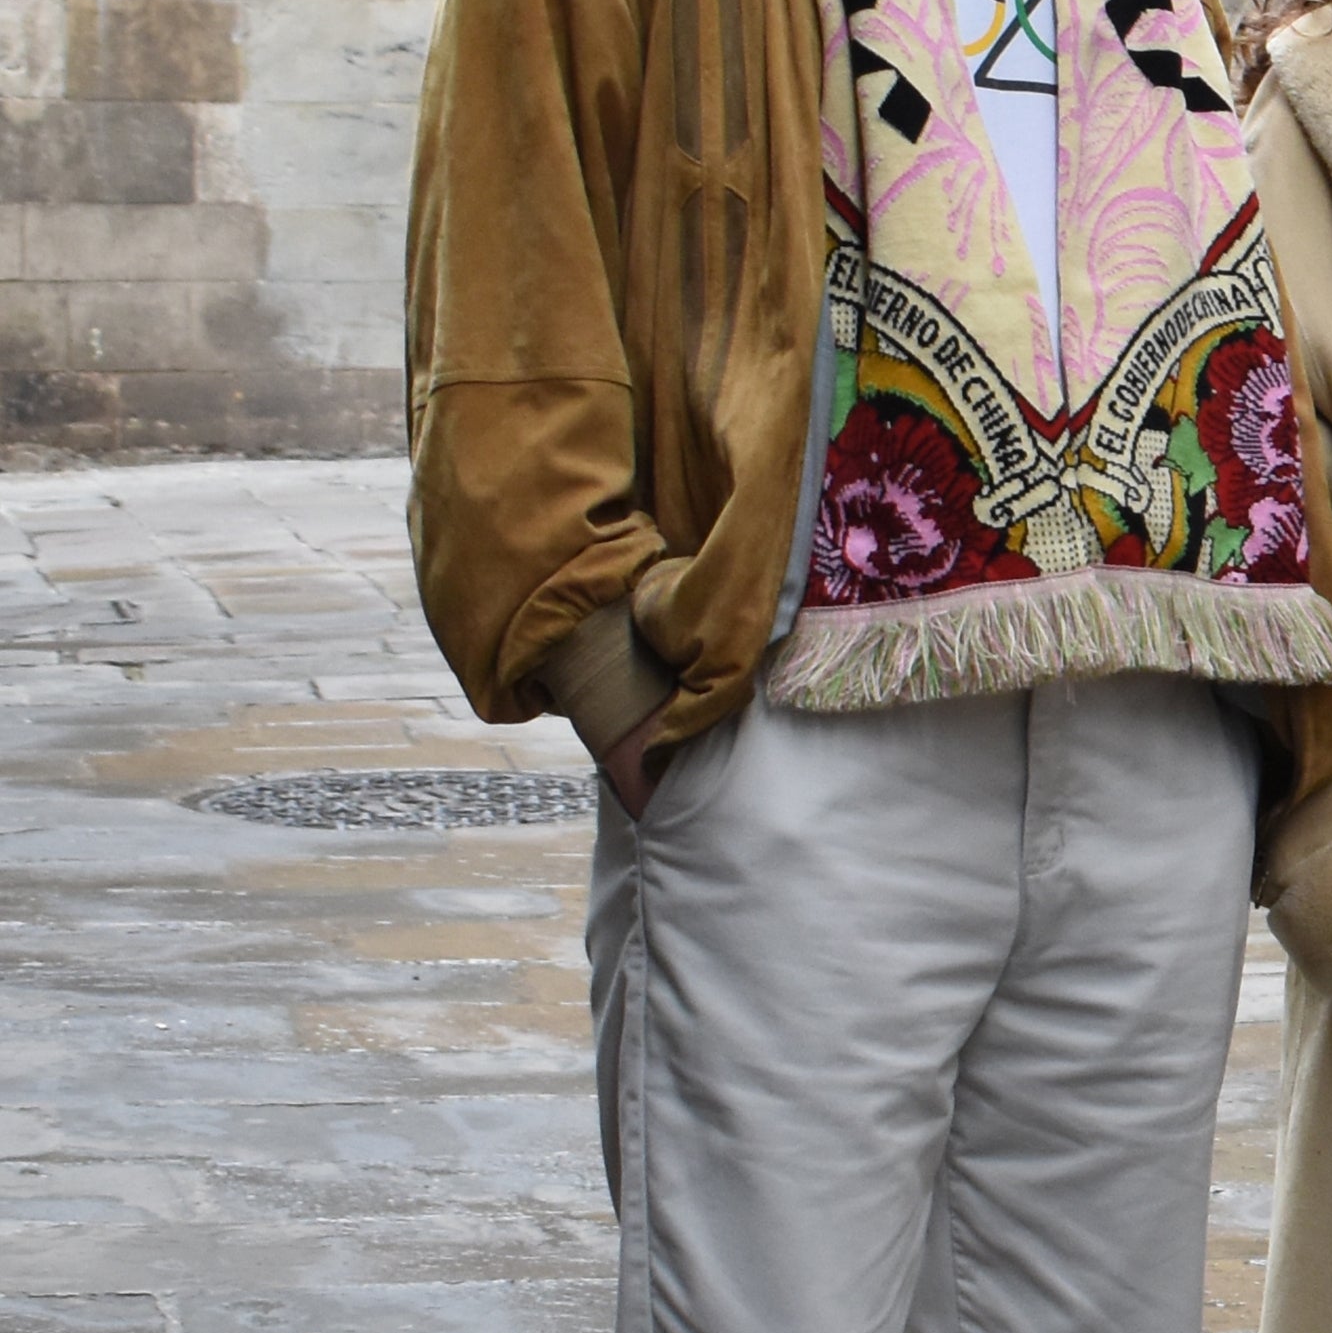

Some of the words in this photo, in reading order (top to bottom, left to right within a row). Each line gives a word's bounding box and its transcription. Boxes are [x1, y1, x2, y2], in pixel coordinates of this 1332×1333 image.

[1191, 283, 1254, 320] CHINA
[1175, 302, 1199, 339] DE
[829, 252, 861, 294] EL
[932, 334, 976, 383] DE
[961, 376, 1028, 475] CHINA
[1107, 326, 1178, 423] GOBIERNO
[1095, 423, 1131, 456] EL
